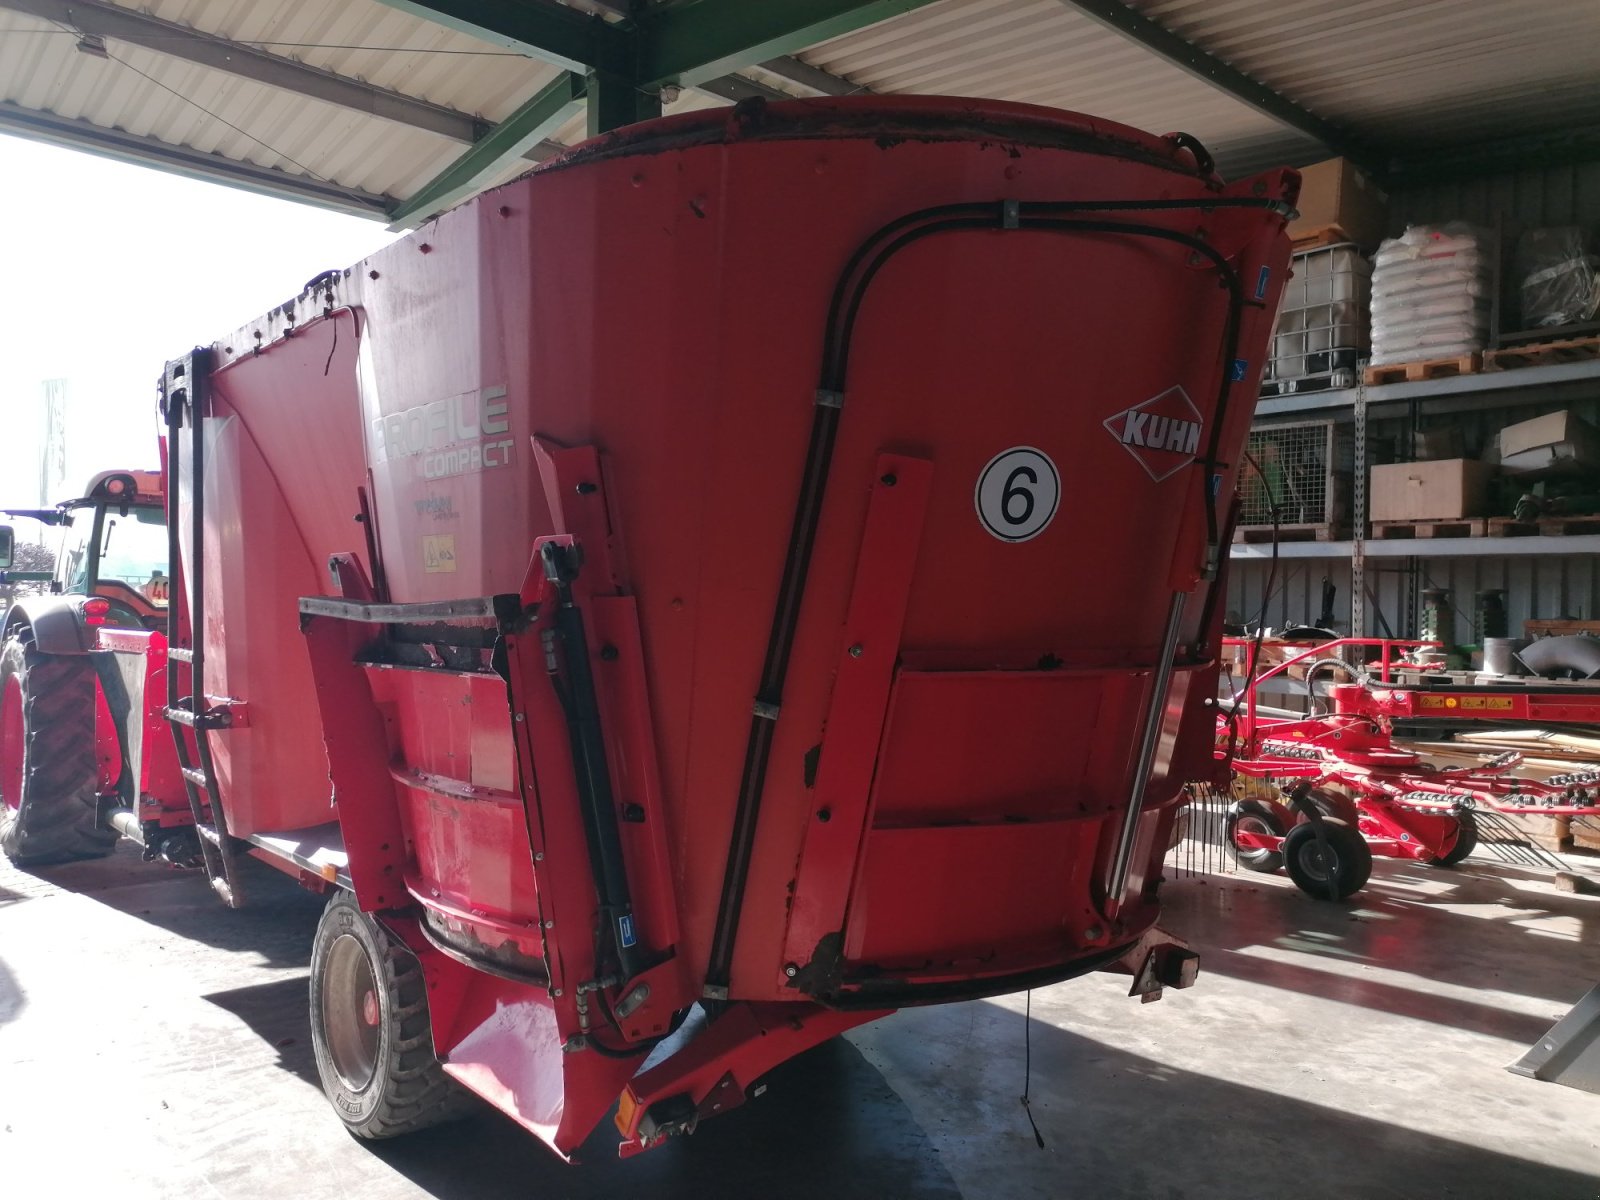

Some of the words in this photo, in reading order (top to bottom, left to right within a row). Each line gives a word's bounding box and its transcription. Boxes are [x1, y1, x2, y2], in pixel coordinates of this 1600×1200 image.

[1122, 409, 1202, 455] KUHN
[423, 439, 513, 479] COMPACT
[1001, 466, 1038, 526] 6
